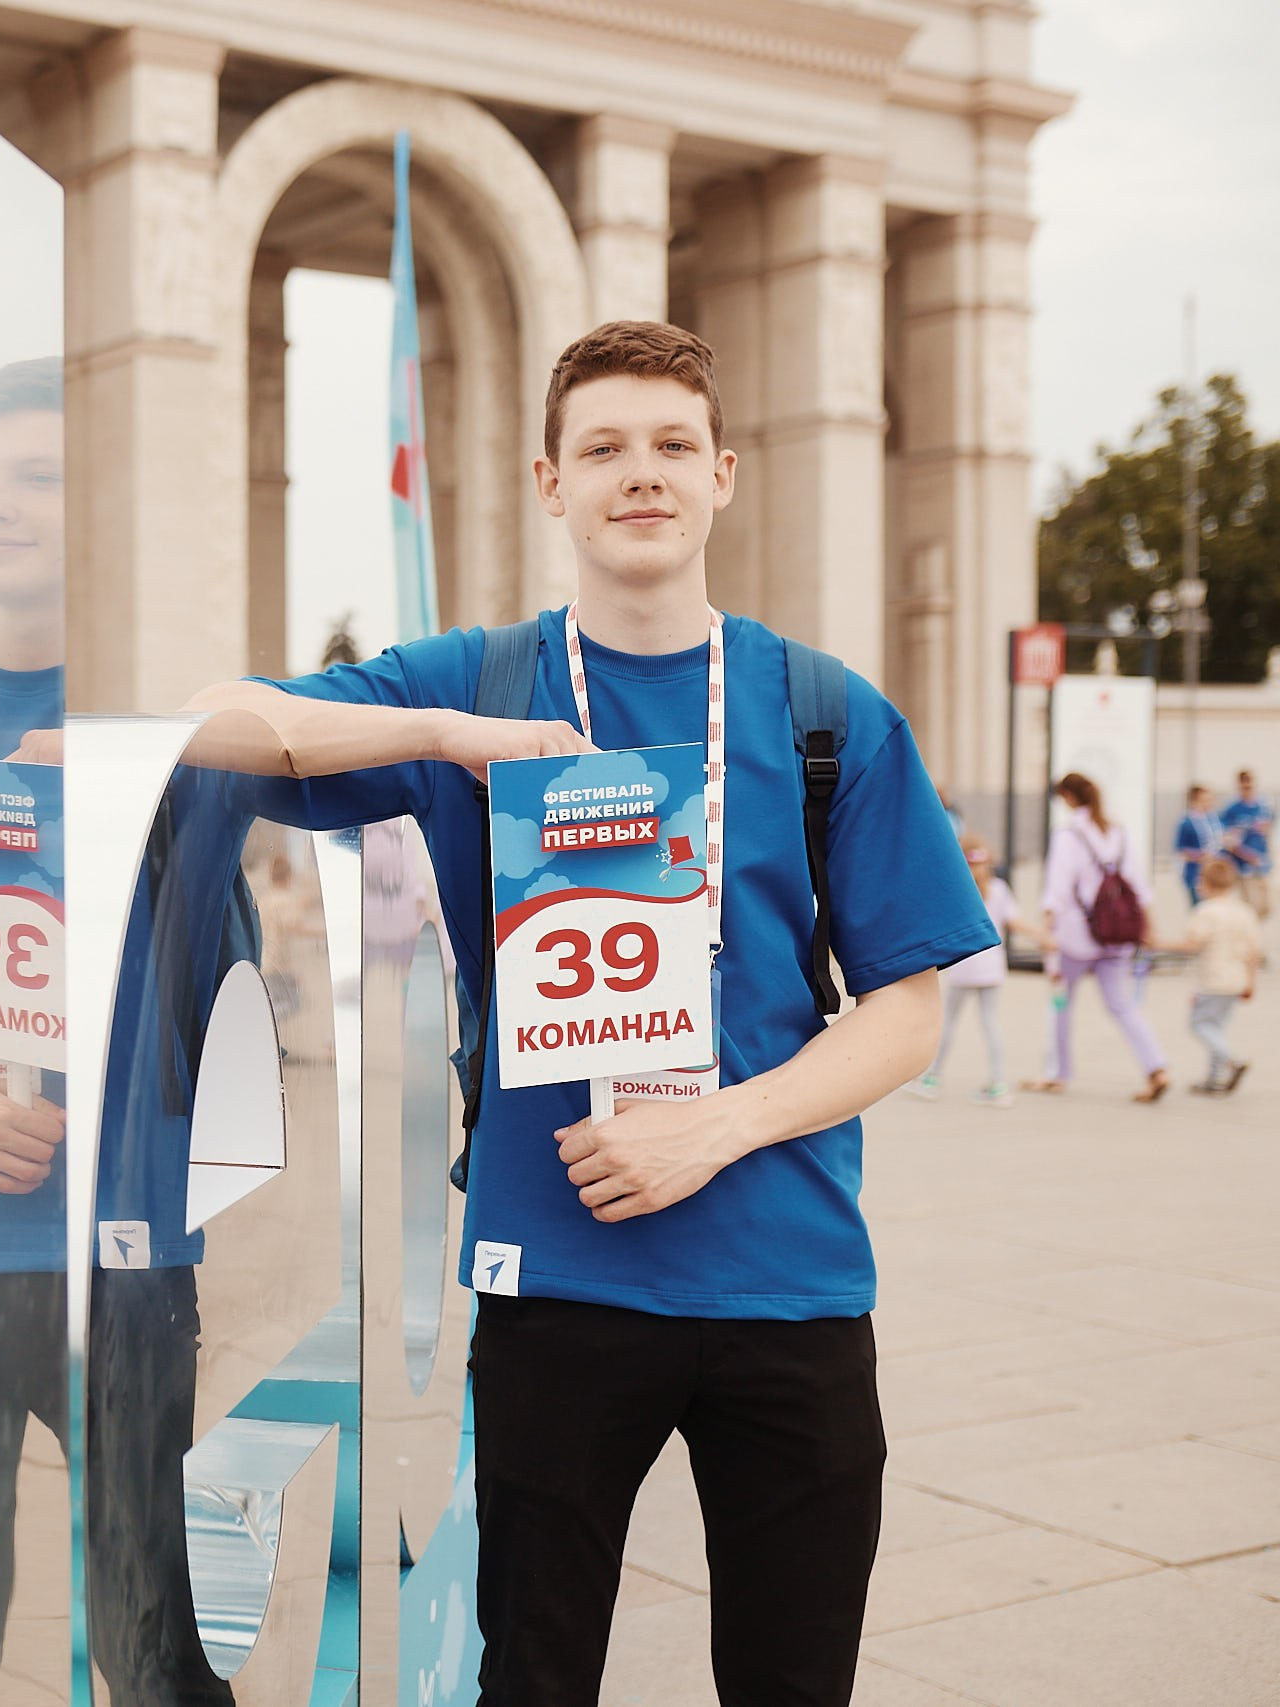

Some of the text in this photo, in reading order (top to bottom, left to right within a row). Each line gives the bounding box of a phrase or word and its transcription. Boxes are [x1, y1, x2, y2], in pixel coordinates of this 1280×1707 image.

[543, 783, 654, 805] ФЕСТИВАЛЬ
[543, 800, 655, 825] ДВИЖЕНИЯ
[543, 821, 655, 848] ПЕРВЫХ
[535, 921, 660, 1000] 39
[516, 1008, 695, 1053] КОМАНДА
[613, 1081, 701, 1097] ВОЖАТЫЙ
